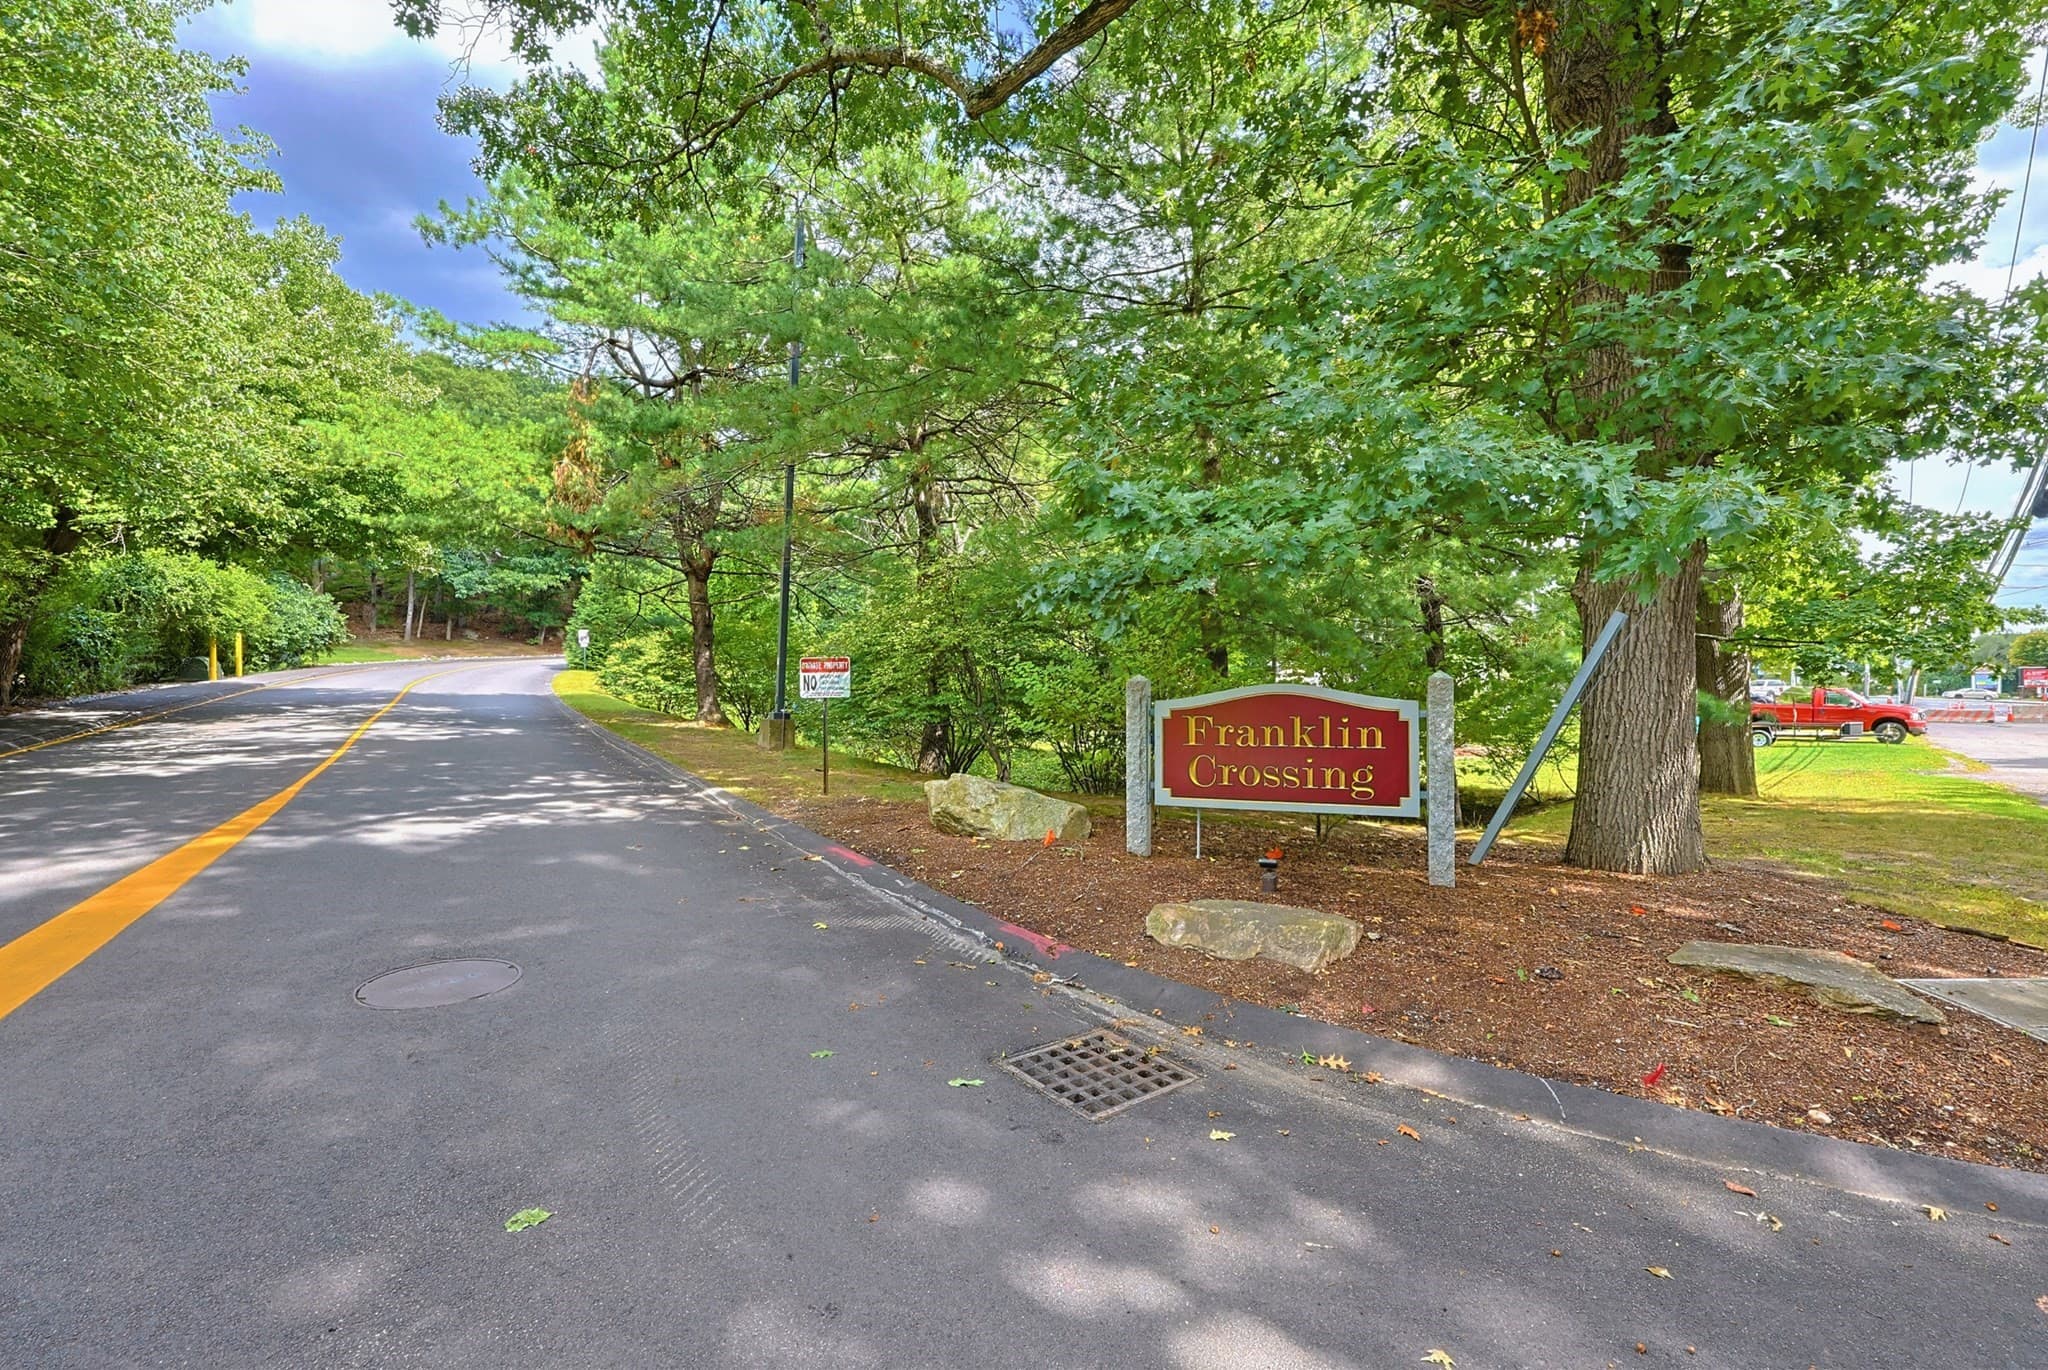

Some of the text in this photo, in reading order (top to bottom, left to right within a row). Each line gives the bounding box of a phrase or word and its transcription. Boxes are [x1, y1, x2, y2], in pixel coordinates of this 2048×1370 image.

[803, 675, 817, 691] NO
[1182, 715, 1386, 749] Franklin
[1188, 754, 1375, 800] Crossing
